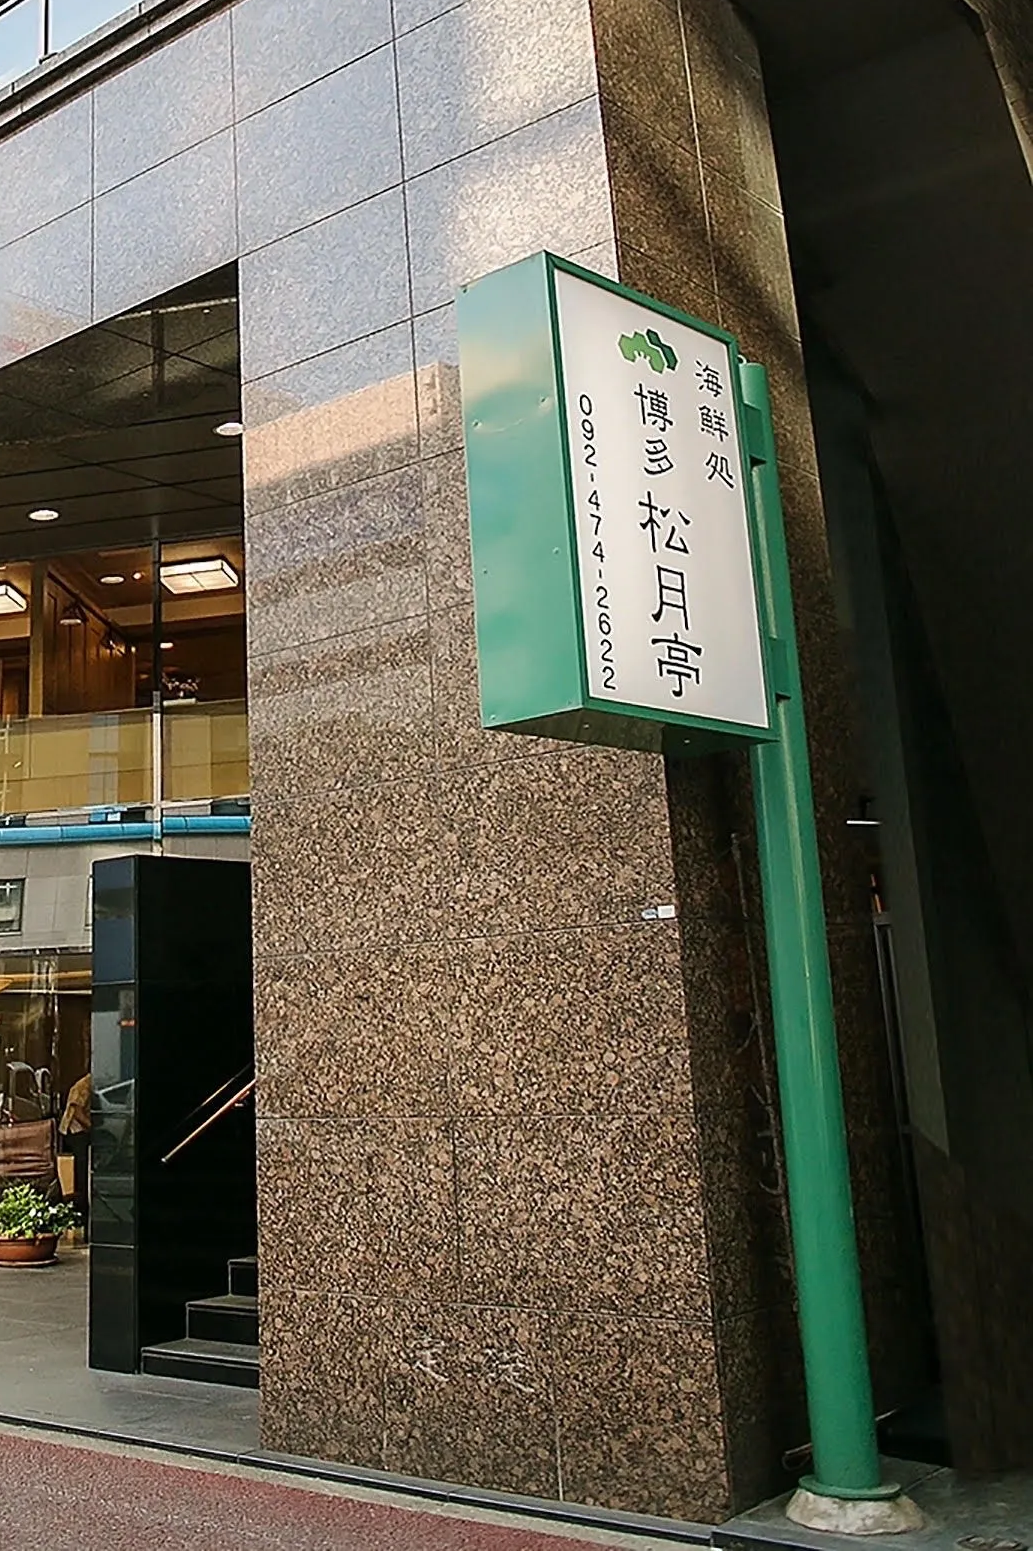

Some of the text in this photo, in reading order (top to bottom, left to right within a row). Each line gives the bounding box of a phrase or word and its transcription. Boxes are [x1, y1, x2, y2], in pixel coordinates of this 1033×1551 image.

[579, 394, 616, 690] 092-474-2622
[633, 383, 702, 698] 博多松月亭
[695, 360, 734, 489] 海鮮処
